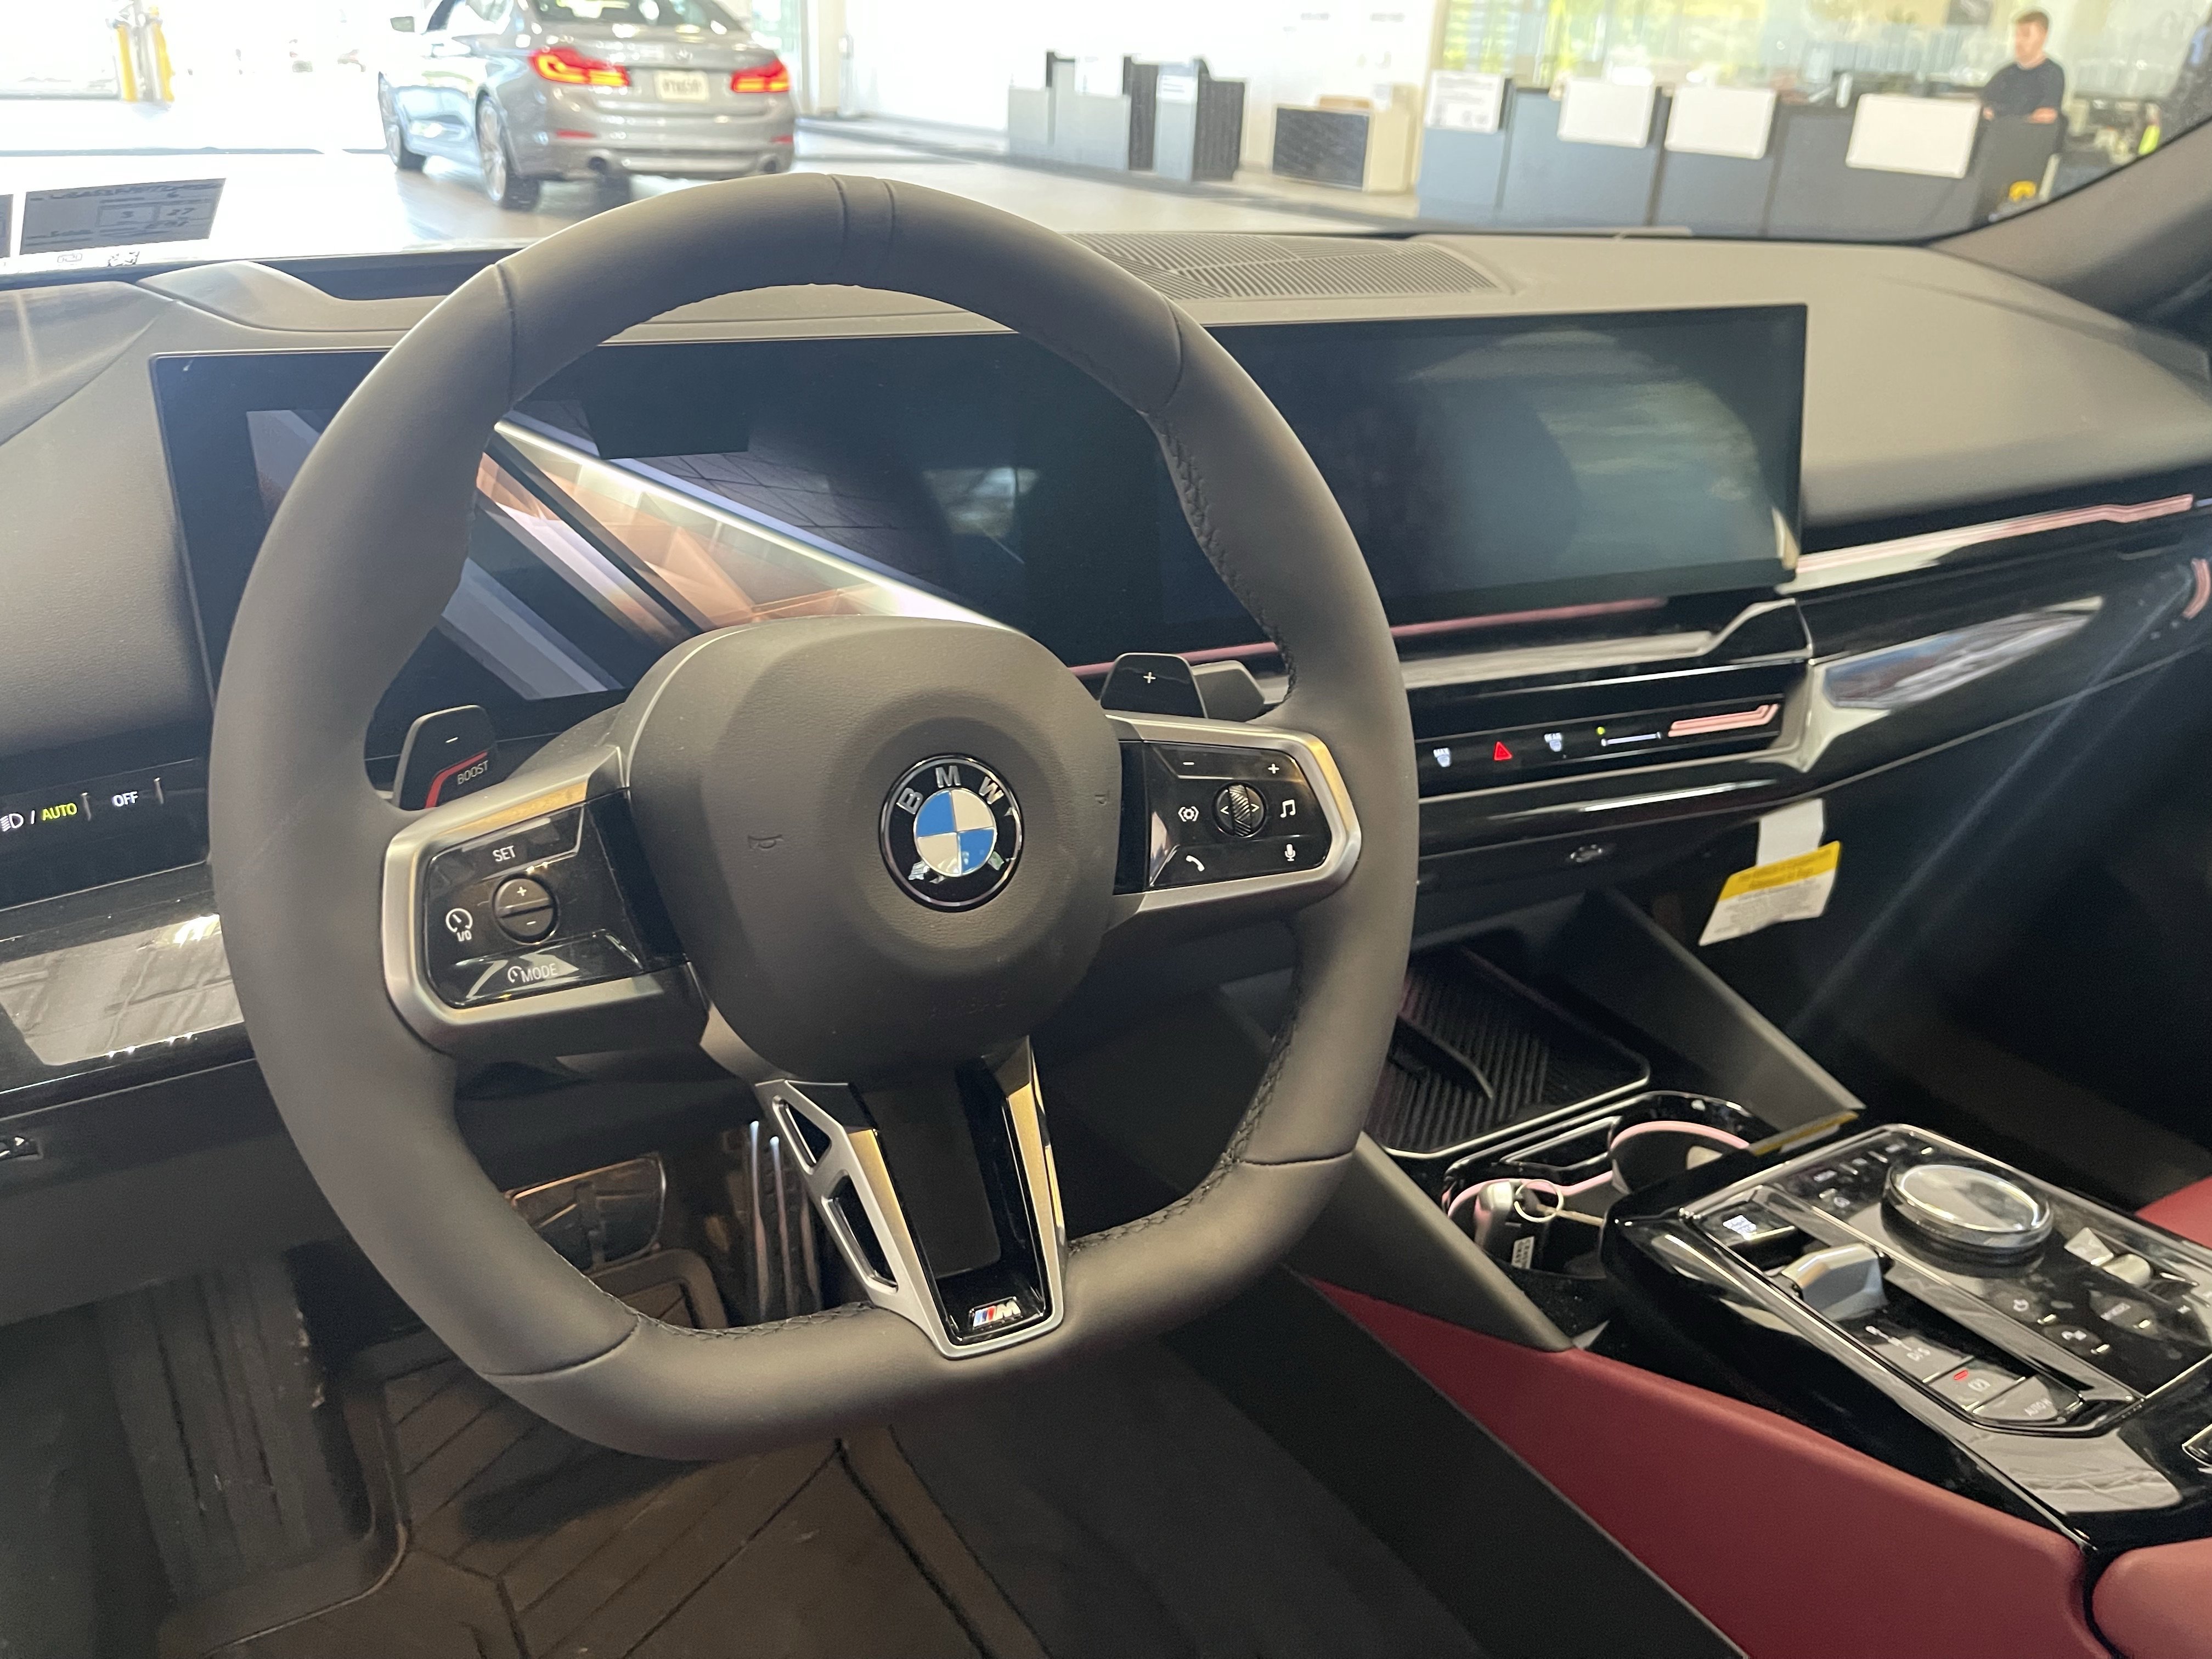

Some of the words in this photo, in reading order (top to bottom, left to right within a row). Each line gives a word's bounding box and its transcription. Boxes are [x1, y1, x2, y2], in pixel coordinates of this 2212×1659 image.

[458, 760, 488, 785] BOOST
[896, 765, 1004, 814] BMW
[112, 791, 138, 807] OFF
[42, 803, 77, 821] AUTO
[493, 845, 515, 862] SET
[521, 963, 558, 982] MODE
